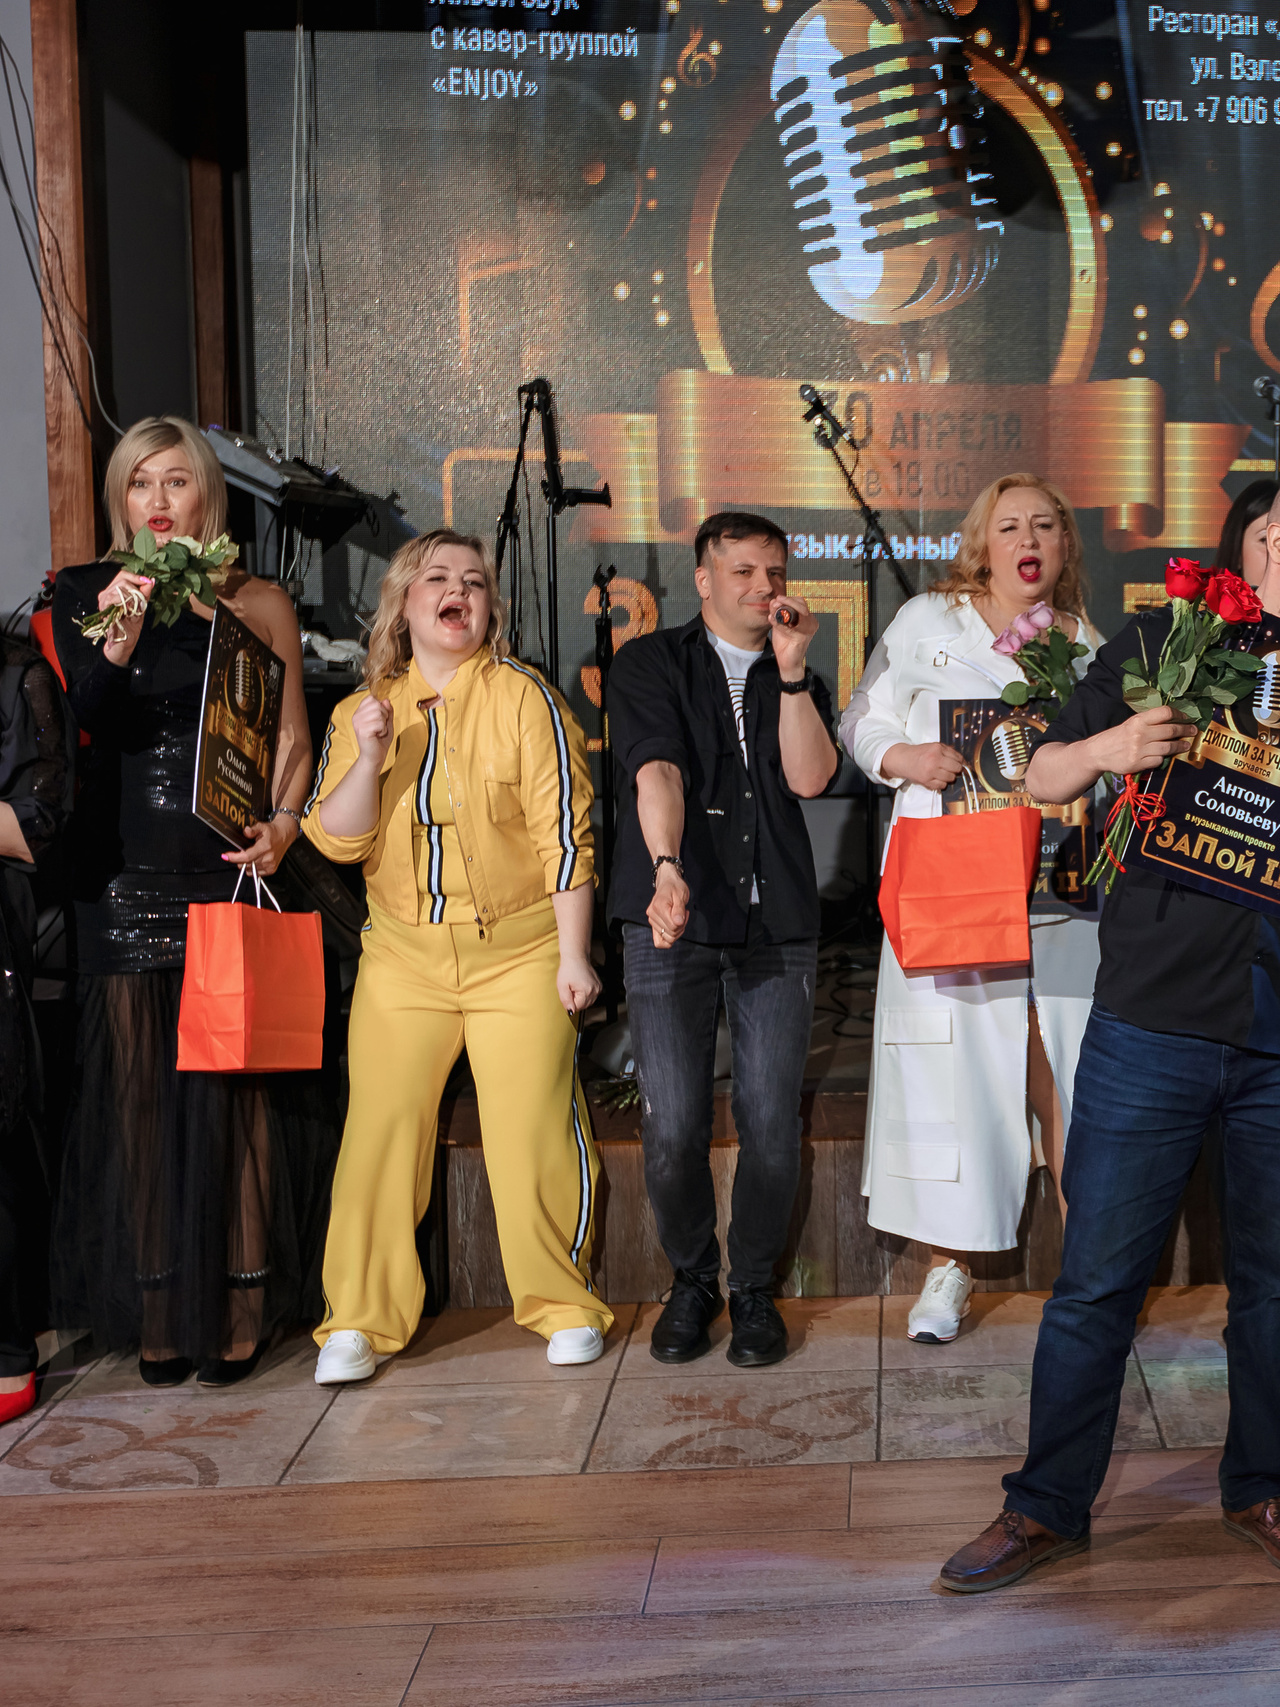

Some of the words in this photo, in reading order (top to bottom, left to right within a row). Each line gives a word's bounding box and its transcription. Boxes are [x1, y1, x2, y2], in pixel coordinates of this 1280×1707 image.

[1148, 5, 1259, 41] Ресторан
[430, 26, 445, 49] с
[453, 26, 638, 60] кавер-группой
[432, 66, 538, 100] «ENJOY»
[1190, 57, 1224, 84] ул.
[1143, 98, 1188, 121] тел.
[1194, 96, 1221, 122] +7
[1226, 95, 1268, 124] 906
[226, 747, 247, 775] Ольге
[1202, 728, 1252, 758] ДИПЛОМ
[1250, 746, 1266, 764] ЗА
[1233, 758, 1272, 778] вручается
[1212, 776, 1276, 814] Антону
[1184, 813, 1191, 821] в
[1191, 815, 1245, 841] музыкальном
[1244, 835, 1276, 852] проекте
